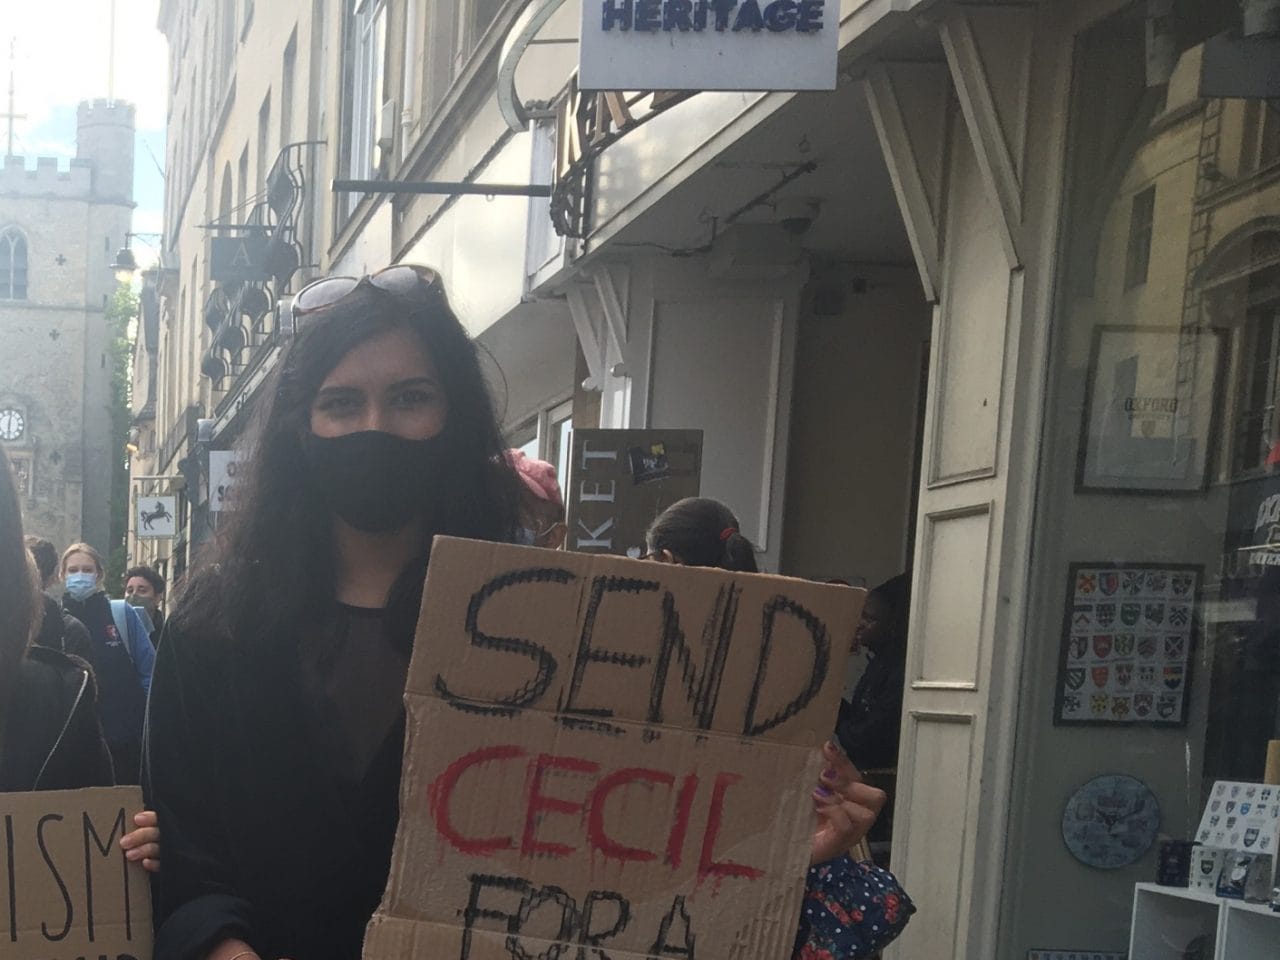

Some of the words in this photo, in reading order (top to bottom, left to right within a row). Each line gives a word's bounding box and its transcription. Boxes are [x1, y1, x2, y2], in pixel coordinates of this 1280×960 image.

[602, 0, 823, 32] HERITAGE
[576, 439, 618, 550] KET
[434, 566, 832, 746] SEND
[426, 744, 767, 882] CECIL
